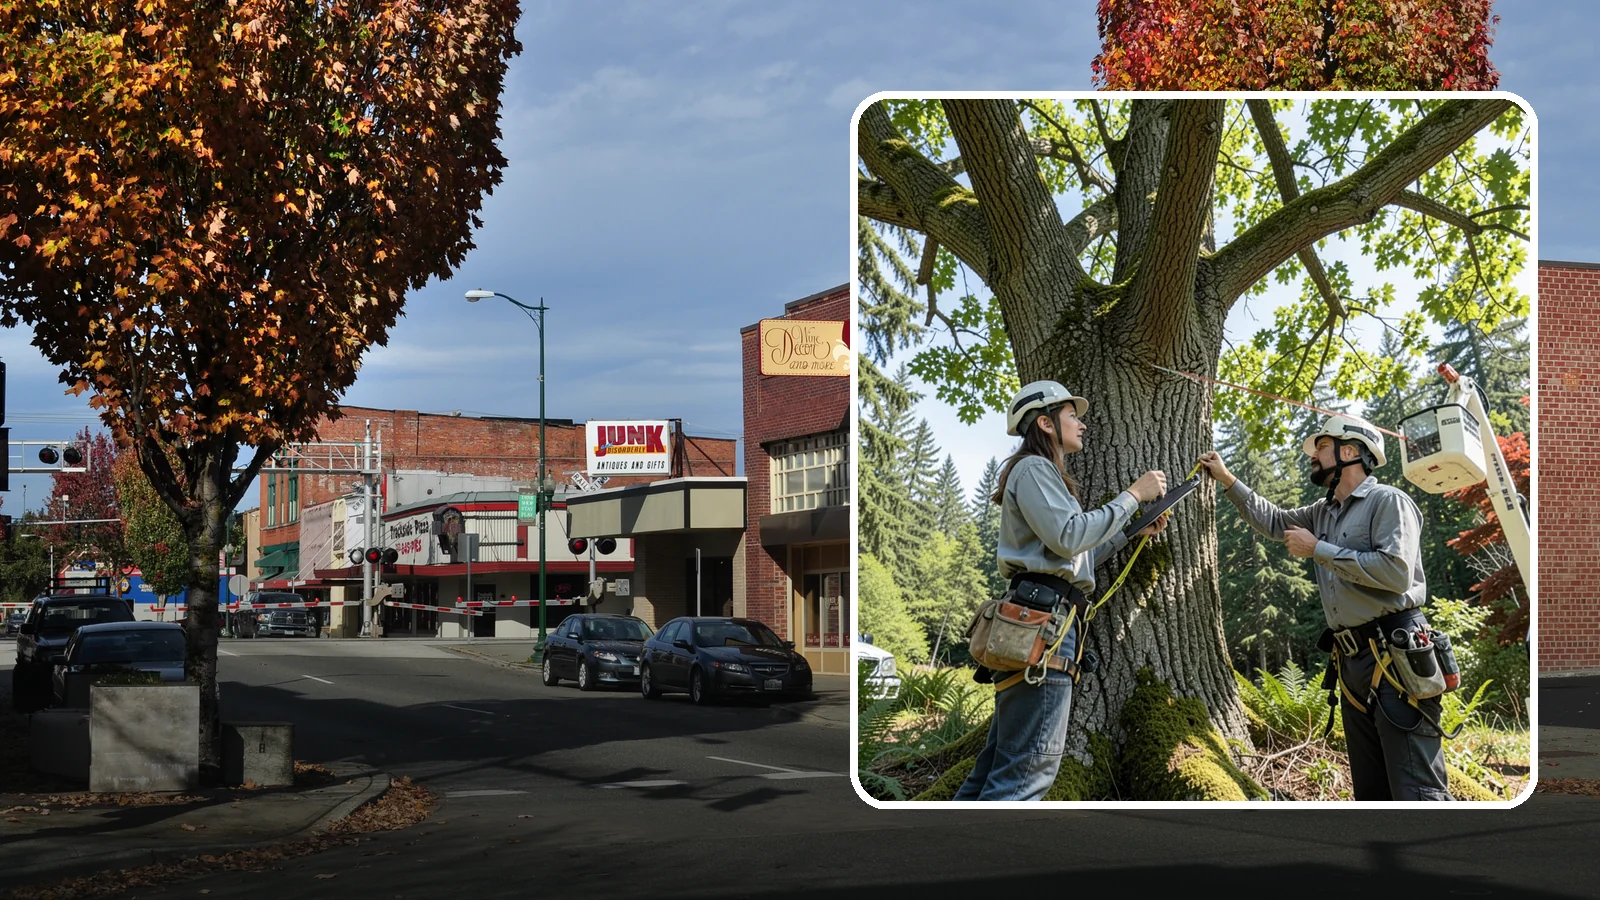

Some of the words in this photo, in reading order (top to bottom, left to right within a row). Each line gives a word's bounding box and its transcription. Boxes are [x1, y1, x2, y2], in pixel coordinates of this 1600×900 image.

[595, 425, 666, 457] JUNK
[607, 446, 646, 454] DISORDERLY
[597, 461, 628, 470] ANTIQUES
[631, 461, 644, 470] AND
[647, 460, 665, 469] GIFTS
[390, 522, 413, 539] Trackside
[415, 519, 429, 534] Pizza
